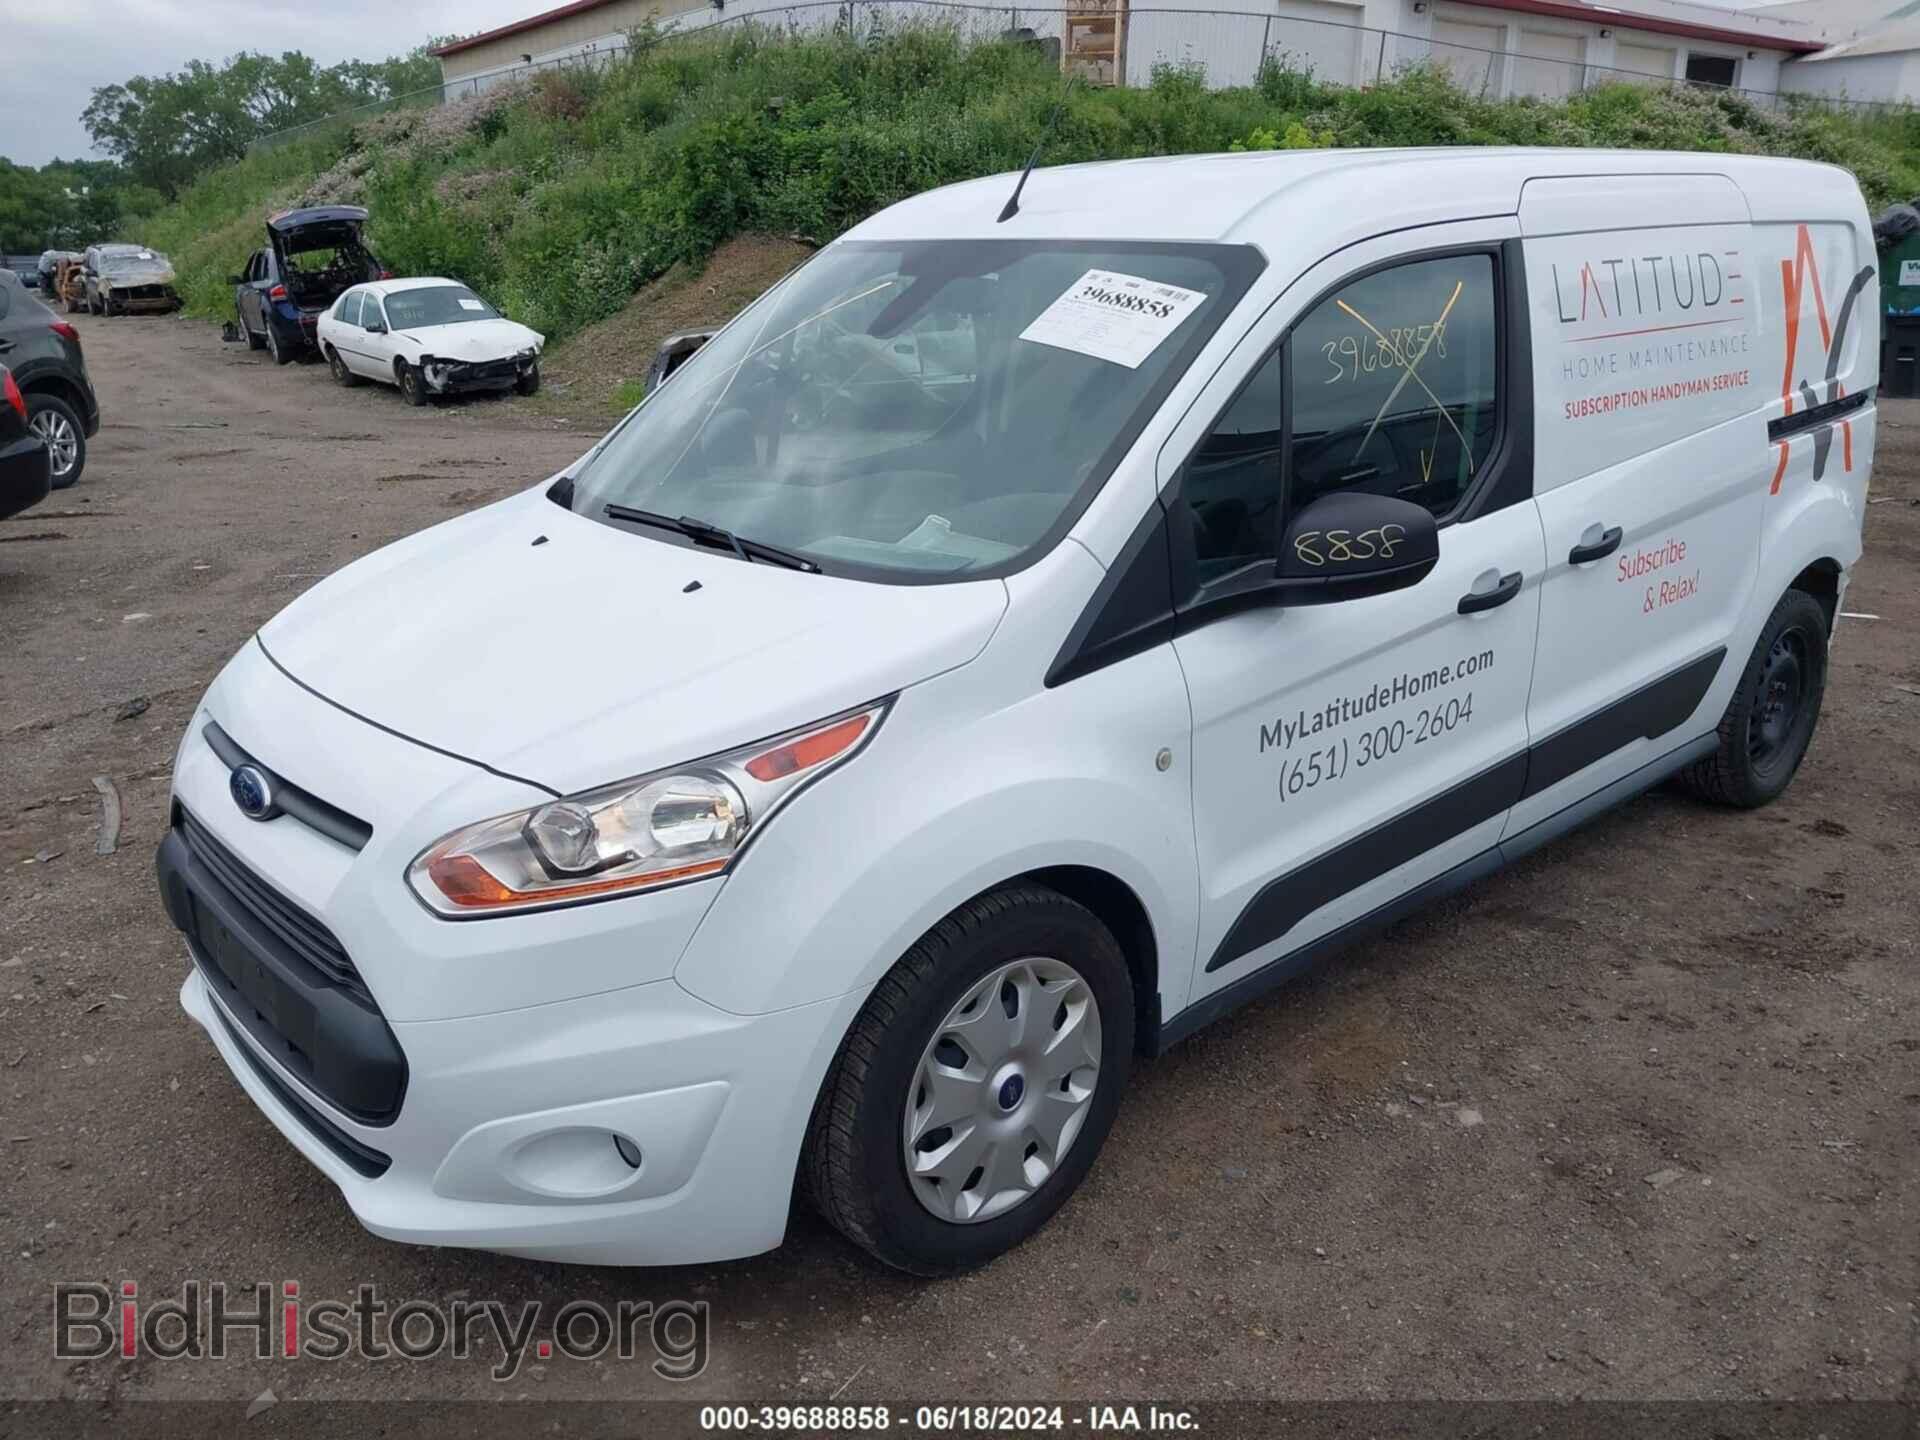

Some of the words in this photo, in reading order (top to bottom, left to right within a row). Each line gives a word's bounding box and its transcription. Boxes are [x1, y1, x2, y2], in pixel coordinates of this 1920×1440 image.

[1075, 285, 1175, 319] 39688858
[1553, 251, 1745, 324] LATITUDE
[1562, 352, 1618, 381] HOME
[1628, 333, 1752, 370] MAINTENANCE
[1565, 388, 1649, 420] SUBSCRIPTION
[1650, 376, 1710, 402] HANDYMAN
[1712, 369, 1749, 392] SERVICE
[1617, 538, 1687, 582] Subscribe
[1643, 586, 1655, 613] &
[1659, 568, 1700, 608] Relax!
[1259, 649, 1494, 753] MyLatitudeHome.com
[1279, 737, 1348, 802] (651)
[1356, 691, 1474, 767] 300-2604
